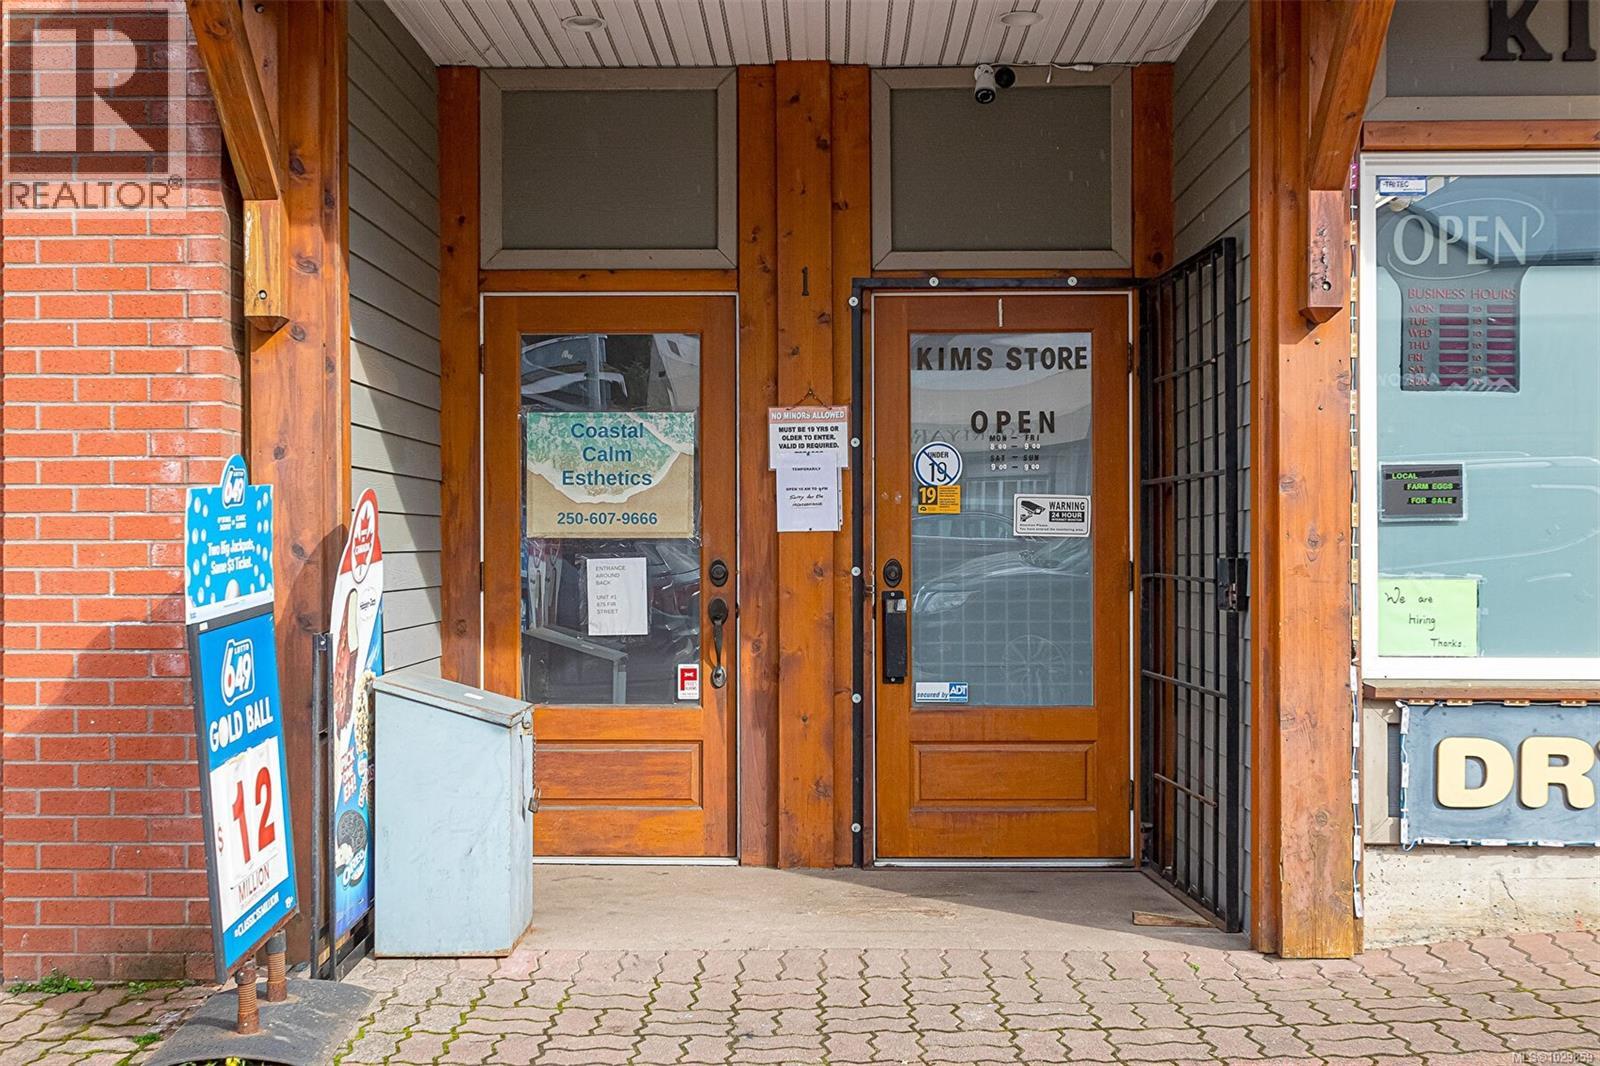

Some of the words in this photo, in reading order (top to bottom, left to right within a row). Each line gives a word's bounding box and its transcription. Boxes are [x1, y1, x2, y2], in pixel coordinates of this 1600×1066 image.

[1393, 214, 1527, 265] OPEN
[1408, 288, 1466, 299] BUSINESS
[1471, 288, 1517, 299] HOURS
[1408, 304, 1434, 313] MON
[1408, 317, 1429, 325] TUE
[1408, 328, 1433, 337] WED
[1408, 341, 1430, 350] THU
[916, 346, 993, 371] KIM'S
[1006, 346, 1088, 370] STORE
[1408, 353, 1424, 361] FRI
[1408, 365, 1425, 374] SAT
[970, 410, 1055, 434] OPEN
[570, 422, 644, 439] Coastal
[582, 446, 632, 462] Calm
[927, 451, 949, 459] UNDER
[990, 454, 1005, 462] SAT
[562, 469, 653, 486] Esthetics
[928, 461, 947, 482] 19
[1431, 482, 1454, 490] EGGS
[919, 486, 937, 504] 19
[1048, 501, 1085, 511] WARNING
[557, 512, 658, 525] 250-607-9666
[1384, 586, 1406, 604] We
[1418, 595, 1434, 604] are
[1408, 613, 1437, 631] hiring
[950, 685, 968, 695] ADT
[209, 711, 244, 752] GOLD
[245, 696, 274, 734] BALL
[232, 766, 276, 865] 12
[238, 862, 270, 904] MILLION
